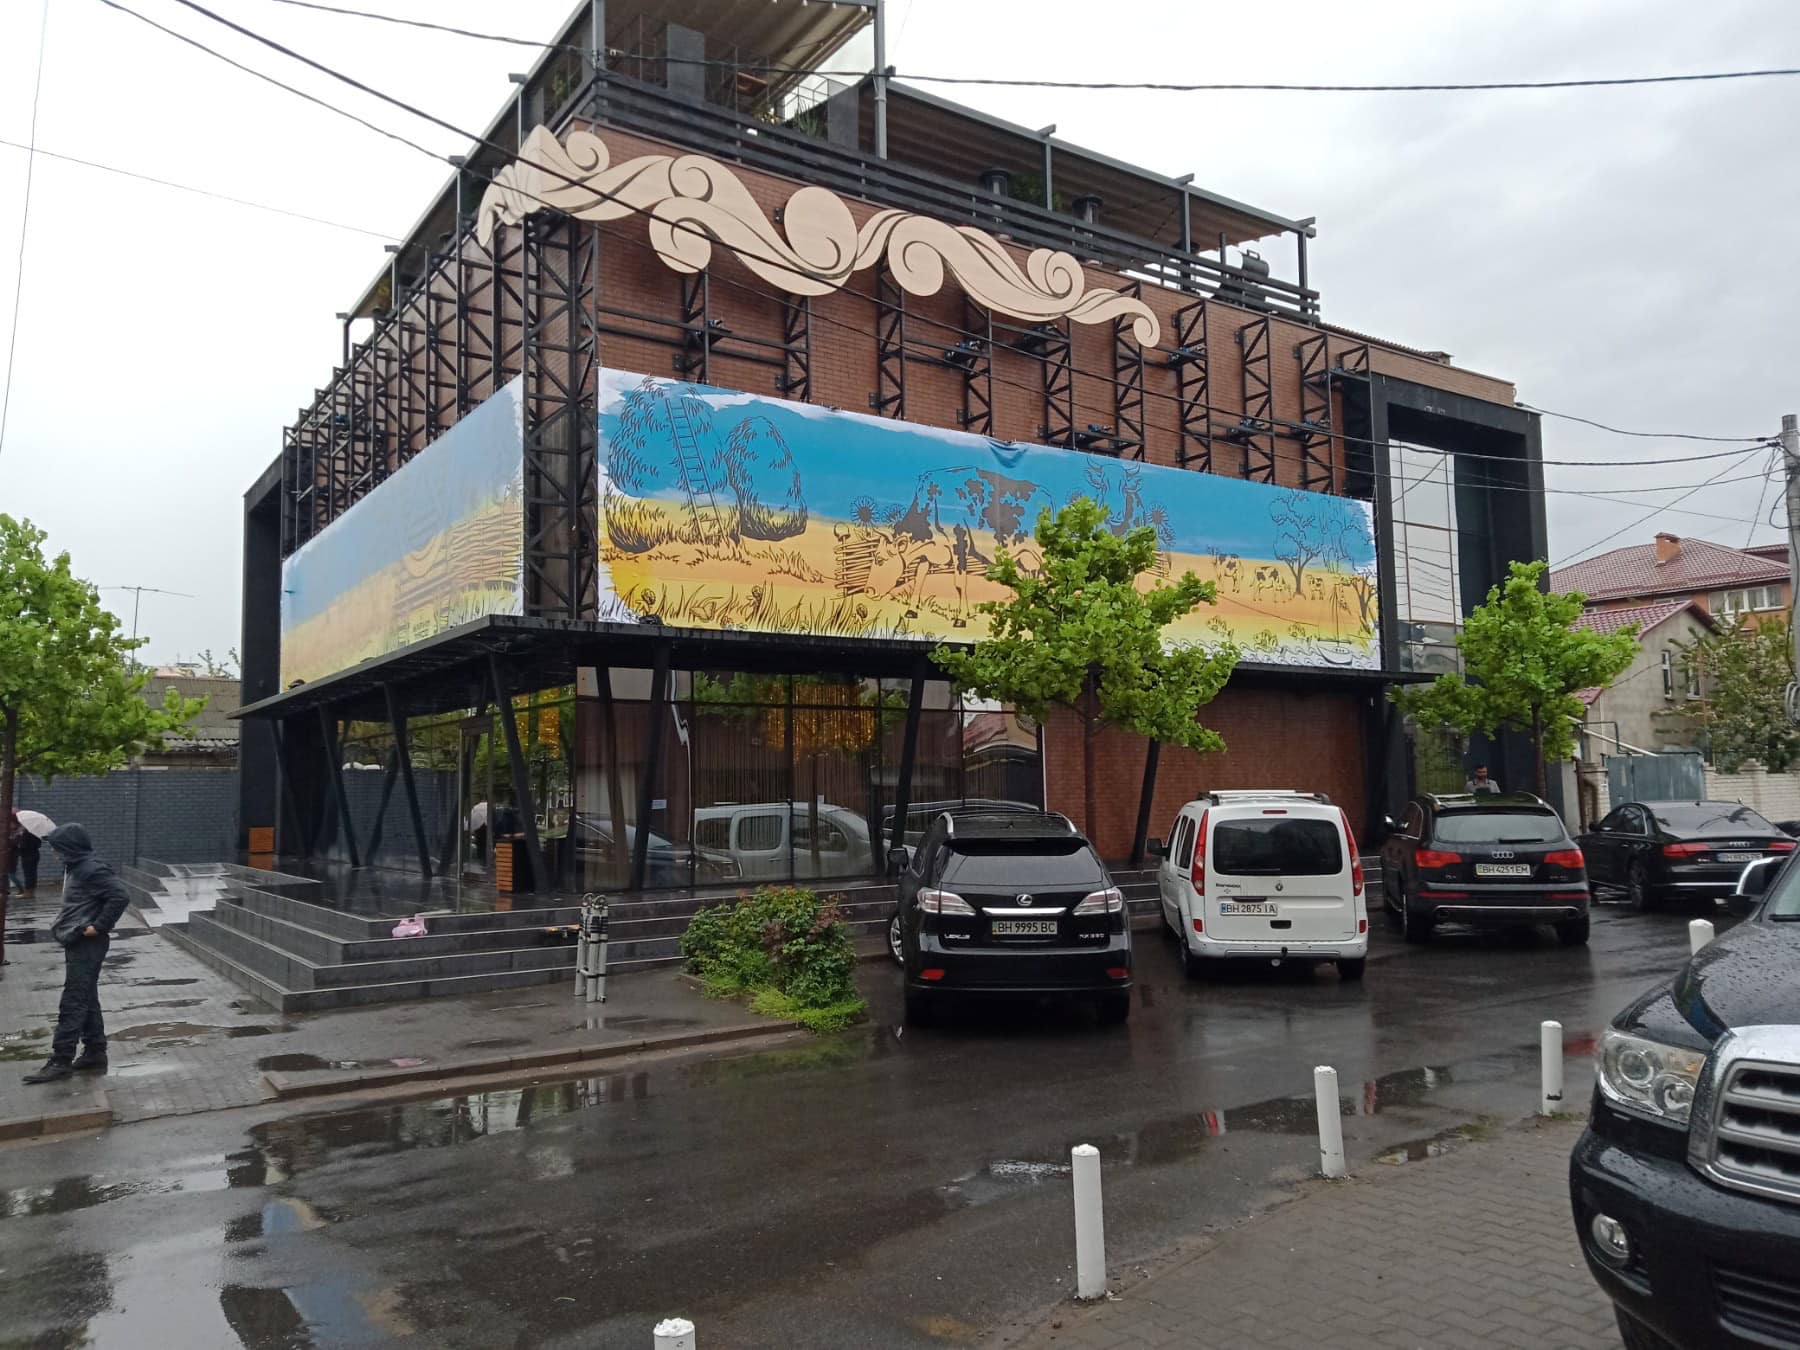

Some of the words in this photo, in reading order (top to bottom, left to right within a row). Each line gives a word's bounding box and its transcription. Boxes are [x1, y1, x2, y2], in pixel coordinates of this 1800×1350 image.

[1226, 903, 1240, 913] BH
[1241, 903, 1262, 913] 2875
[998, 922, 1012, 933] BH
[1015, 922, 1038, 933] 9995
[1040, 922, 1055, 933] BC
